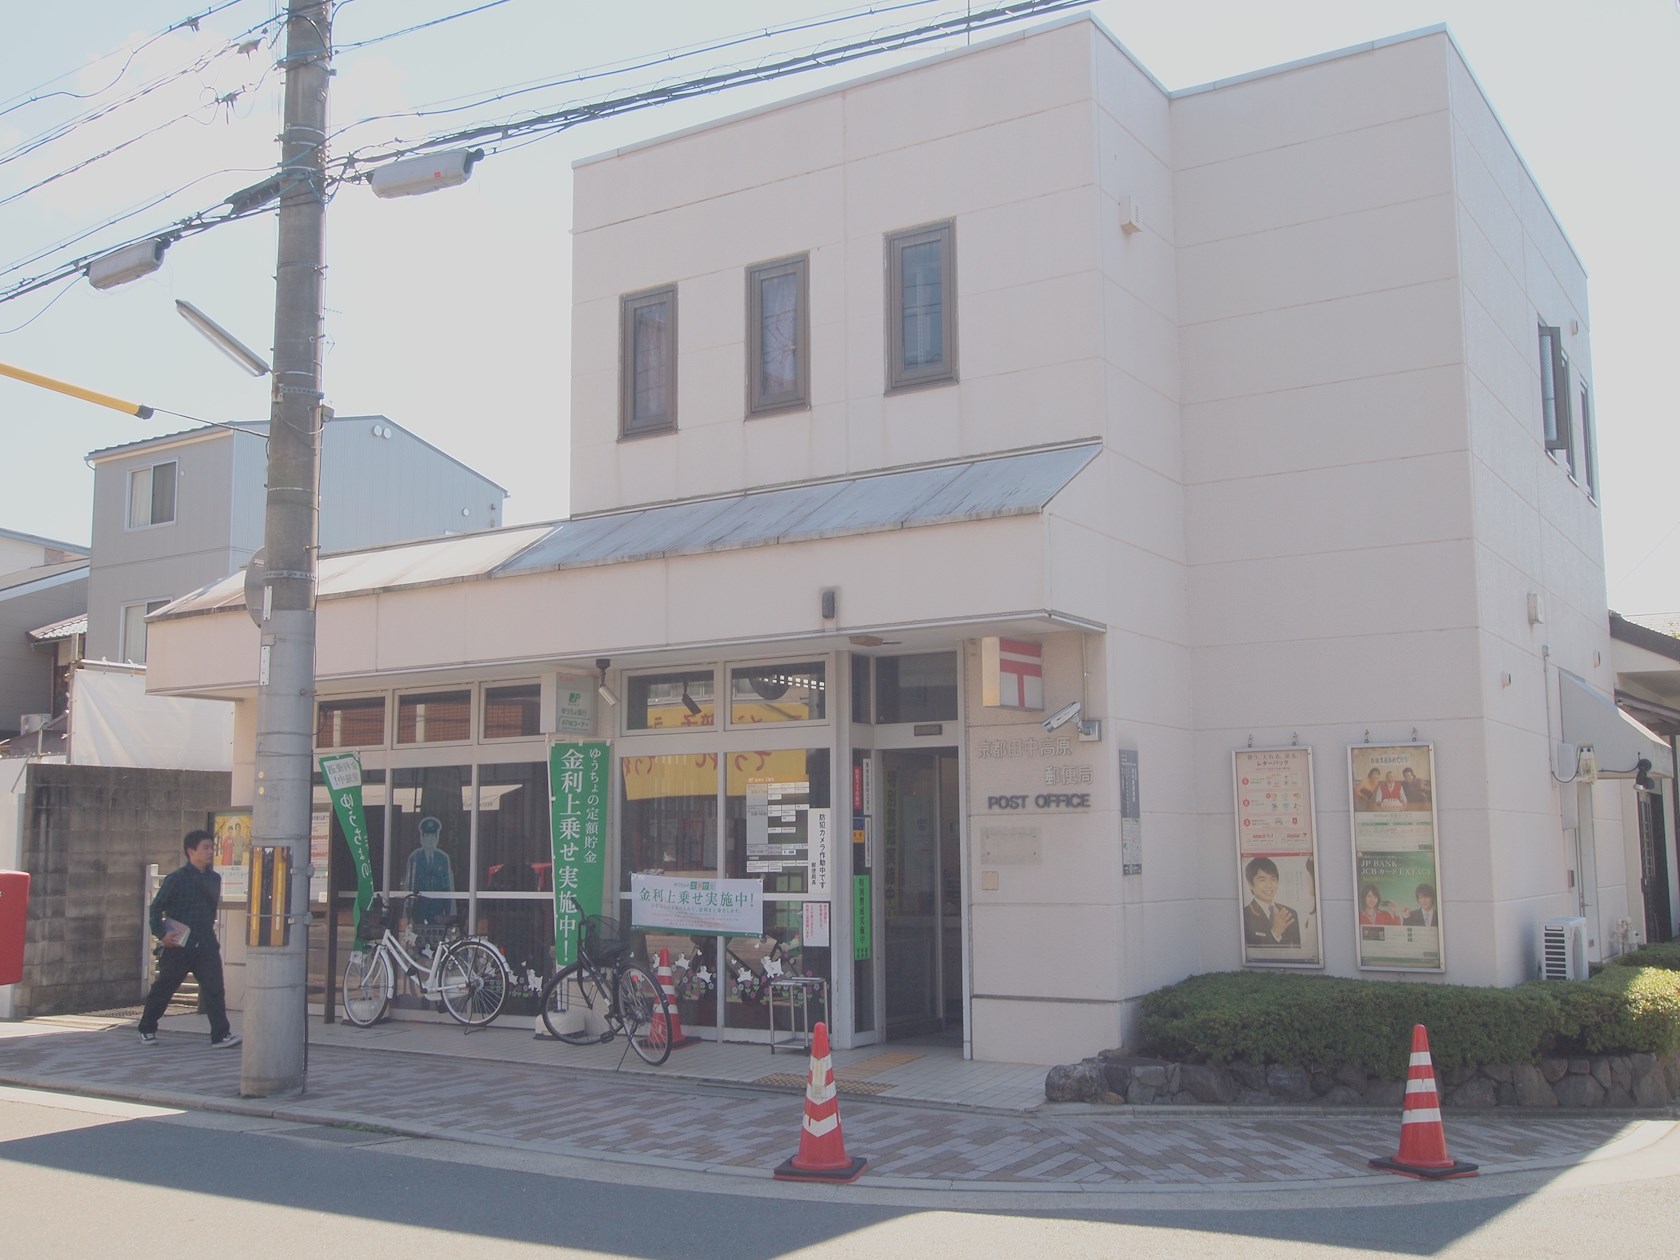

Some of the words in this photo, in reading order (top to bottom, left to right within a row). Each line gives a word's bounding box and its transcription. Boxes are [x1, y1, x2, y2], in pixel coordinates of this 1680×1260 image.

[978, 738, 1071, 759] 京都田中高原
[1044, 766, 1094, 785] 郵便局
[584, 748, 602, 863] ゆうちょの定額貯金
[988, 795, 1028, 809] POST
[1034, 793, 1091, 808] OFFICE
[559, 748, 584, 962] 金利上乗せ実施中!
[639, 887, 754, 908] 金利上乗せ実施中!
